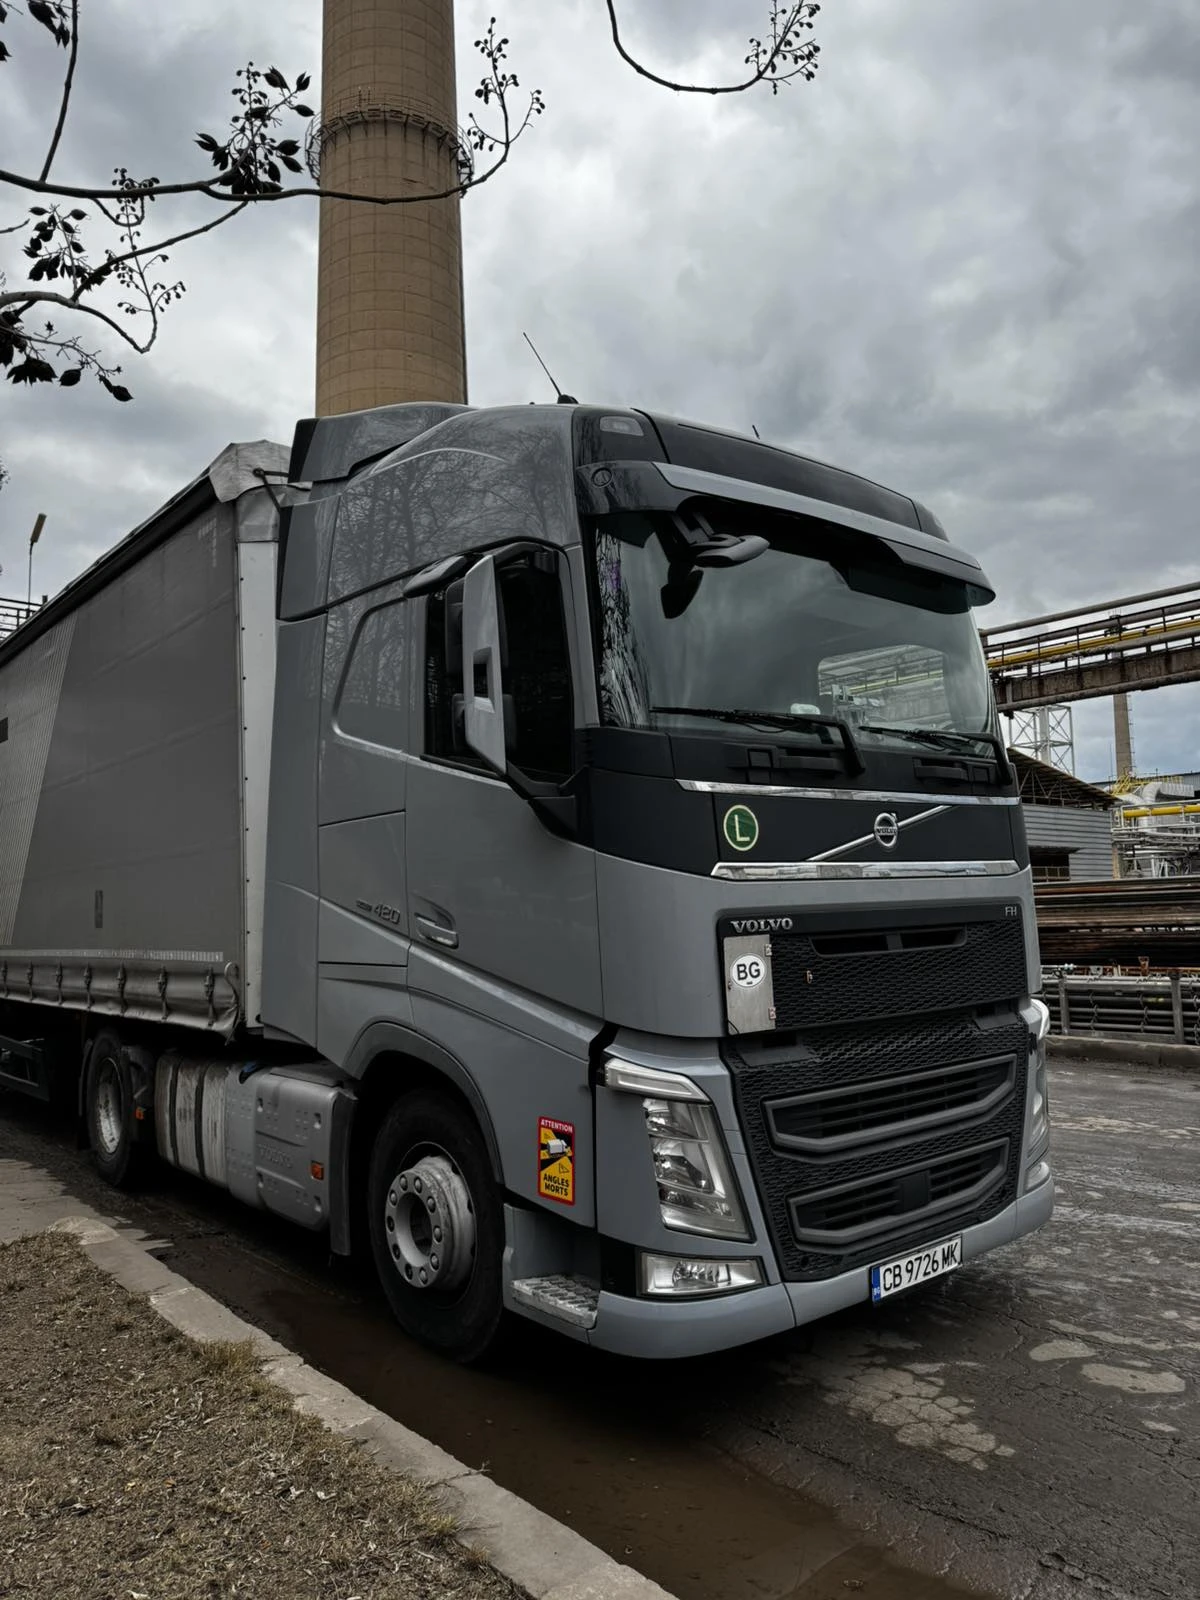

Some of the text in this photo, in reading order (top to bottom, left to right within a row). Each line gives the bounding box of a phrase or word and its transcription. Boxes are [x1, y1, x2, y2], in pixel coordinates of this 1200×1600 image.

[733, 814, 750, 842] L
[374, 903, 401, 925] 420
[1005, 906, 1017, 917] FH
[730, 917, 793, 933] VOLVO
[736, 961, 761, 981] BG
[540, 1119, 573, 1133] ATTENTION
[543, 1173, 570, 1188] ANGLES
[544, 1182, 569, 1197] MORTS
[883, 1242, 958, 1291] CB 9726 MK
